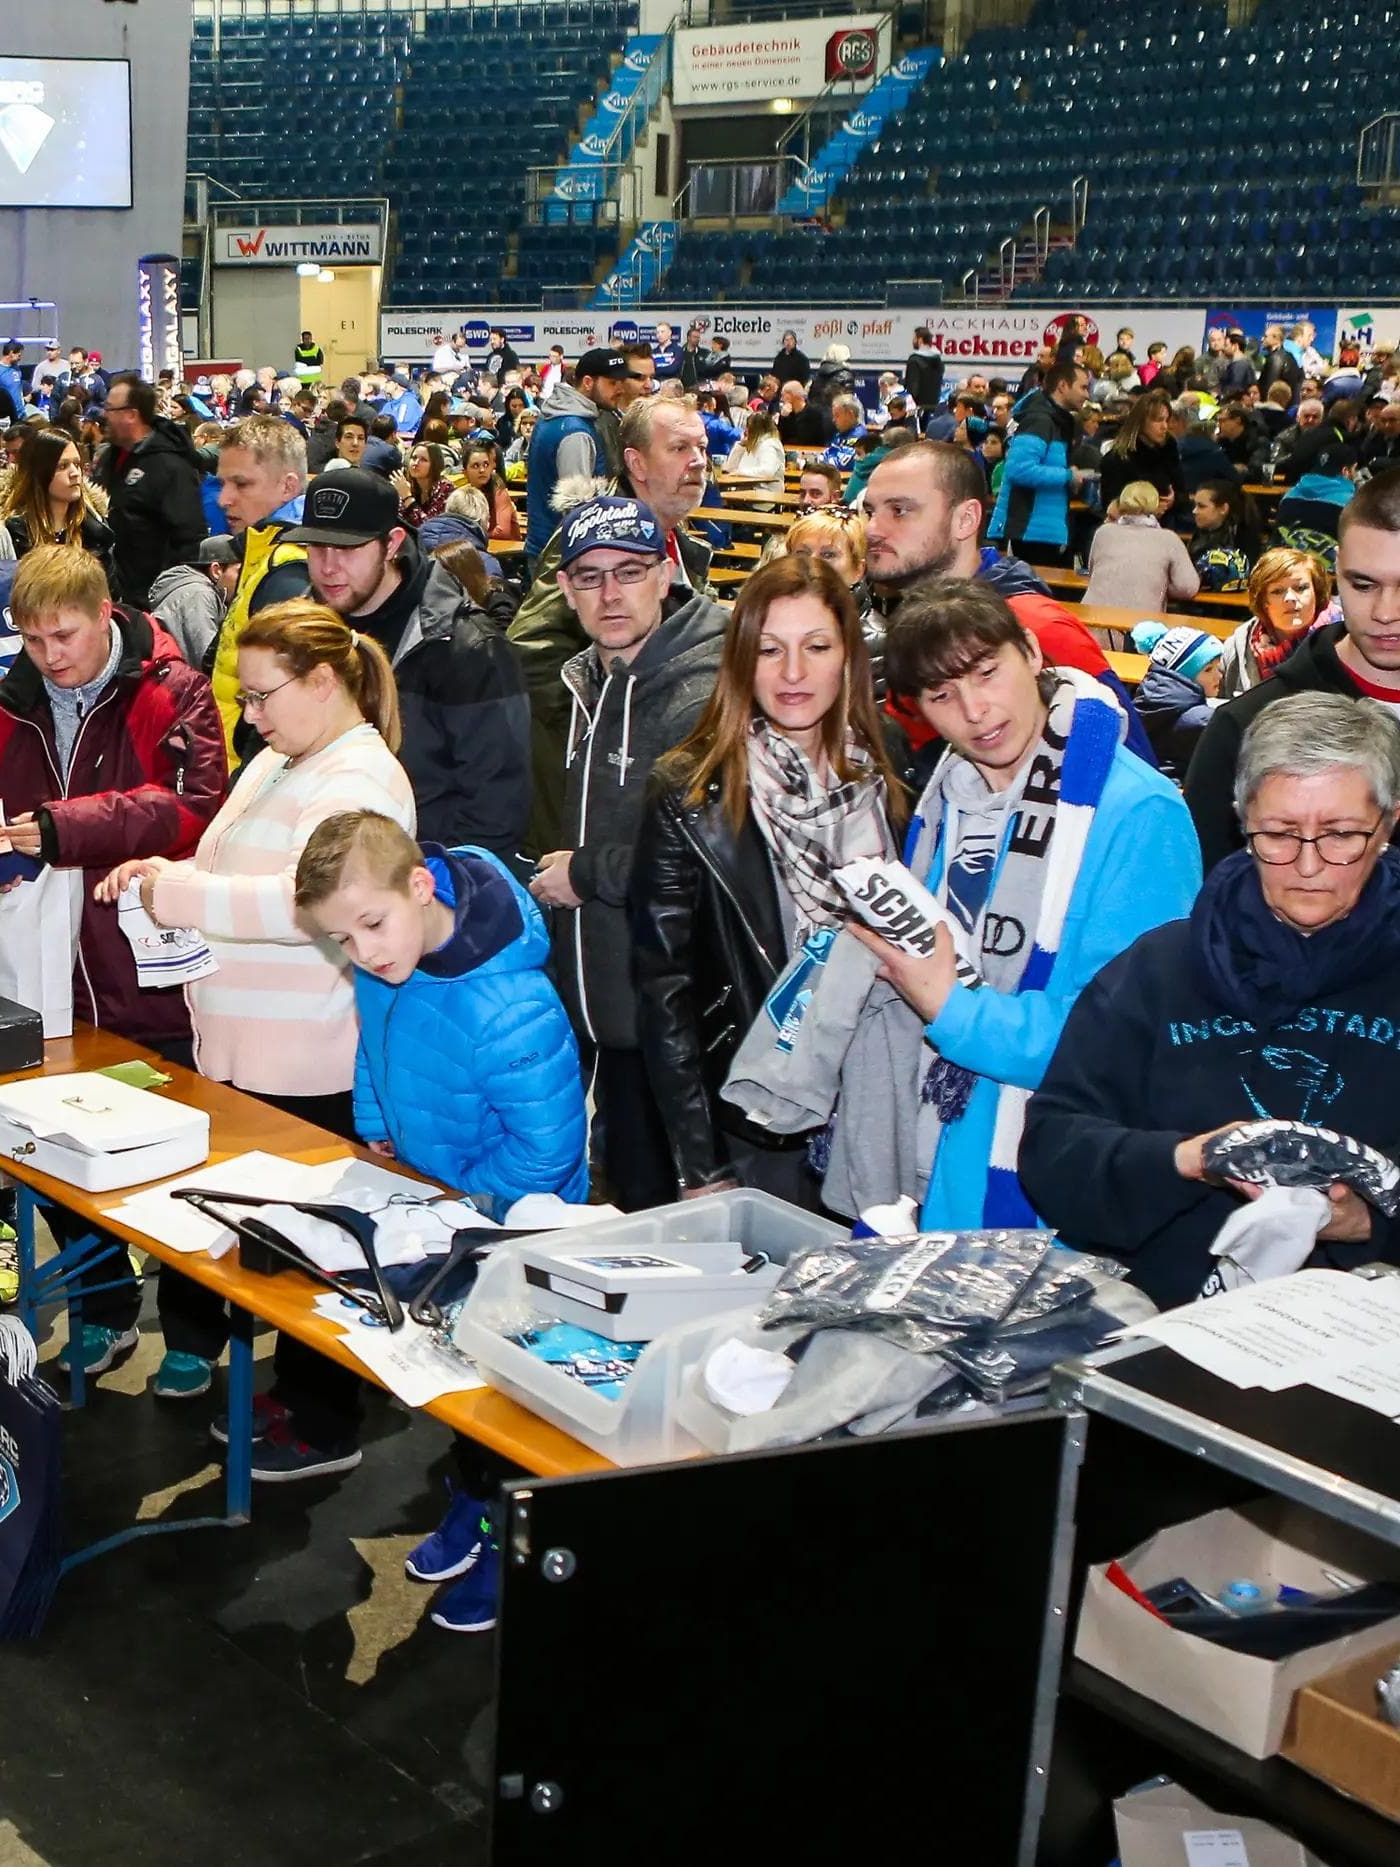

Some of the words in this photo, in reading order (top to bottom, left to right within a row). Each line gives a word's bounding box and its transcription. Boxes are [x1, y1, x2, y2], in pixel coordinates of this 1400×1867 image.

[692, 38, 800, 57] Gebäudetechnik
[692, 77, 800, 92] www.rgs-service.de
[265, 241, 370, 257] WITTMANN
[387, 326, 442, 335] POLESCHAK
[543, 326, 595, 335] POLESCHAK
[713, 316, 772, 333] Eckerle
[814, 319, 843, 338] gößl
[862, 320, 894, 338] pfaff
[925, 318, 1040, 331] BACKHAUS
[567, 502, 639, 548] Ingolstadt
